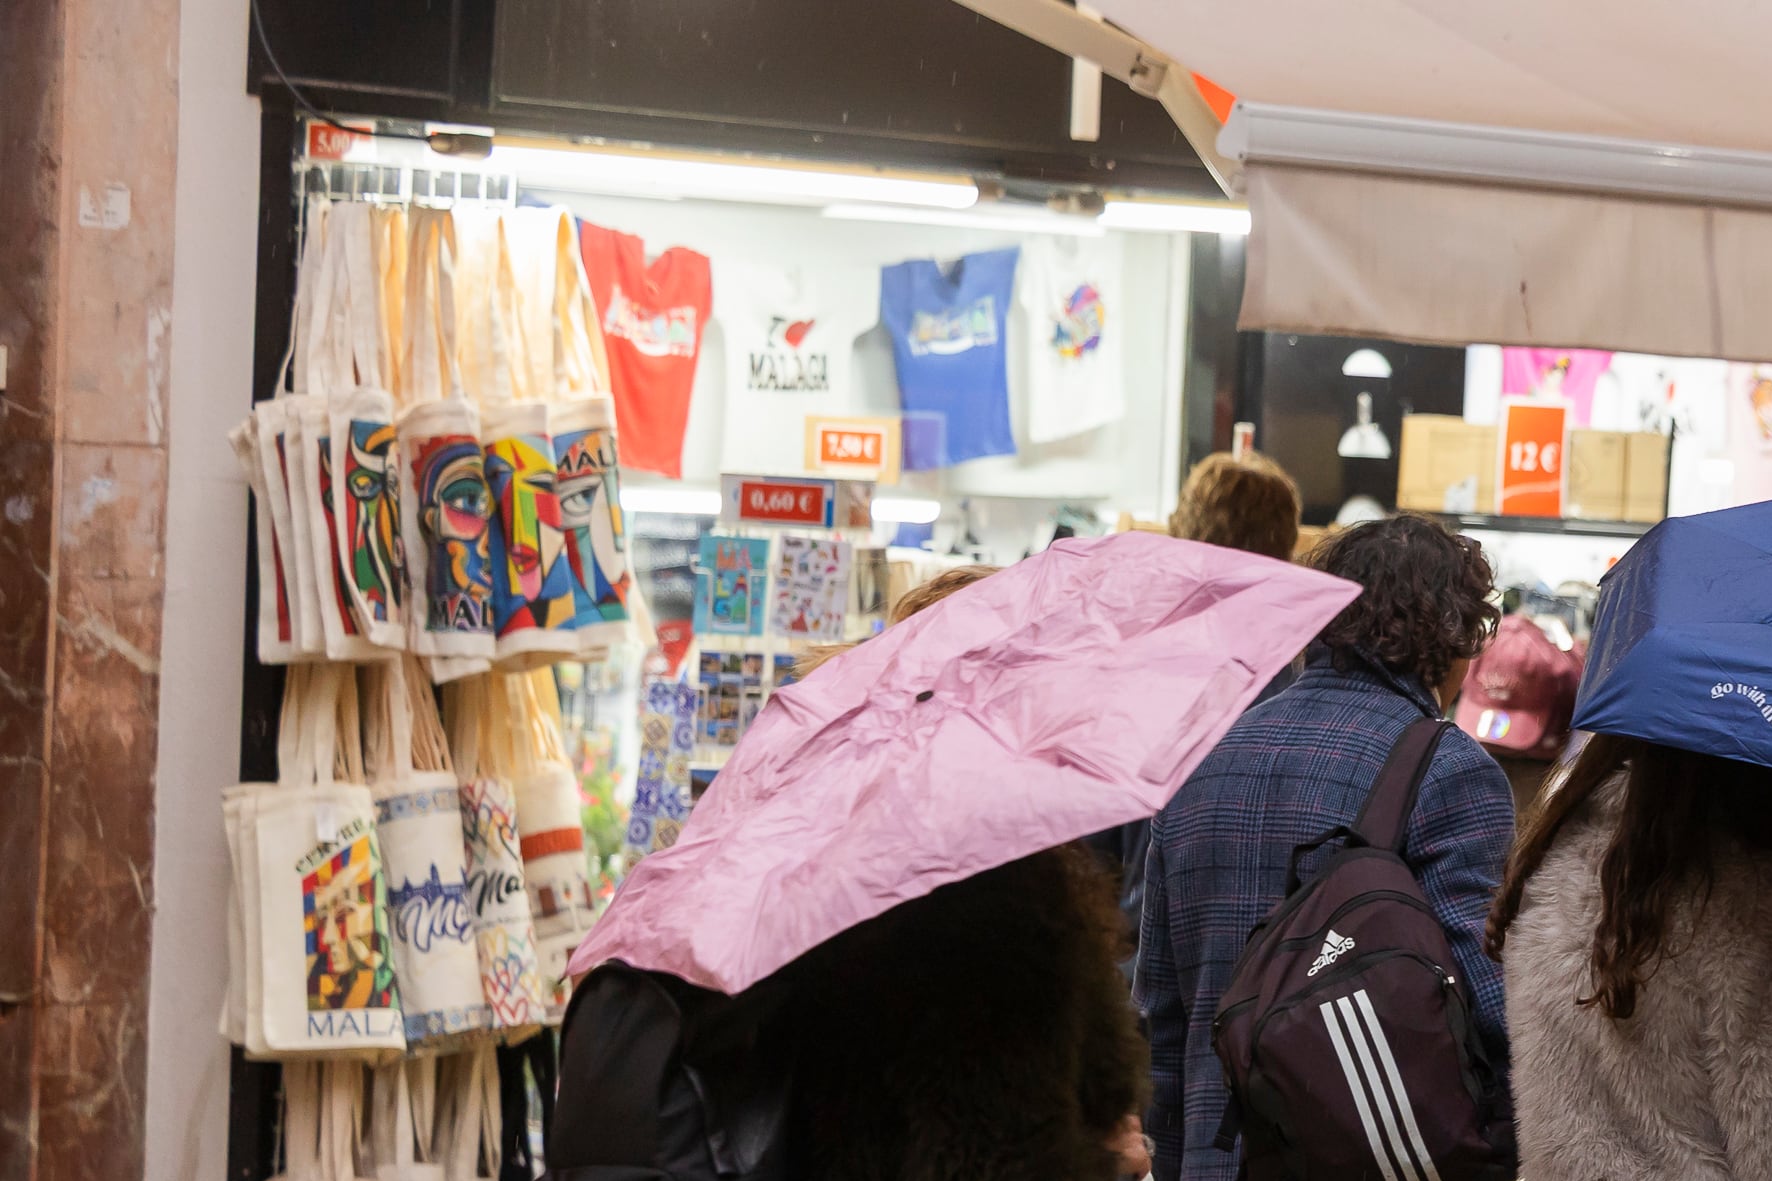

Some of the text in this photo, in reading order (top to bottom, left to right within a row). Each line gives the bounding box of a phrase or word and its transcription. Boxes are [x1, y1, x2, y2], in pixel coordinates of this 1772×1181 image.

[1711, 682, 1734, 699] go
[1736, 683, 1767, 708] with
[1307, 936, 1356, 977] adidas
